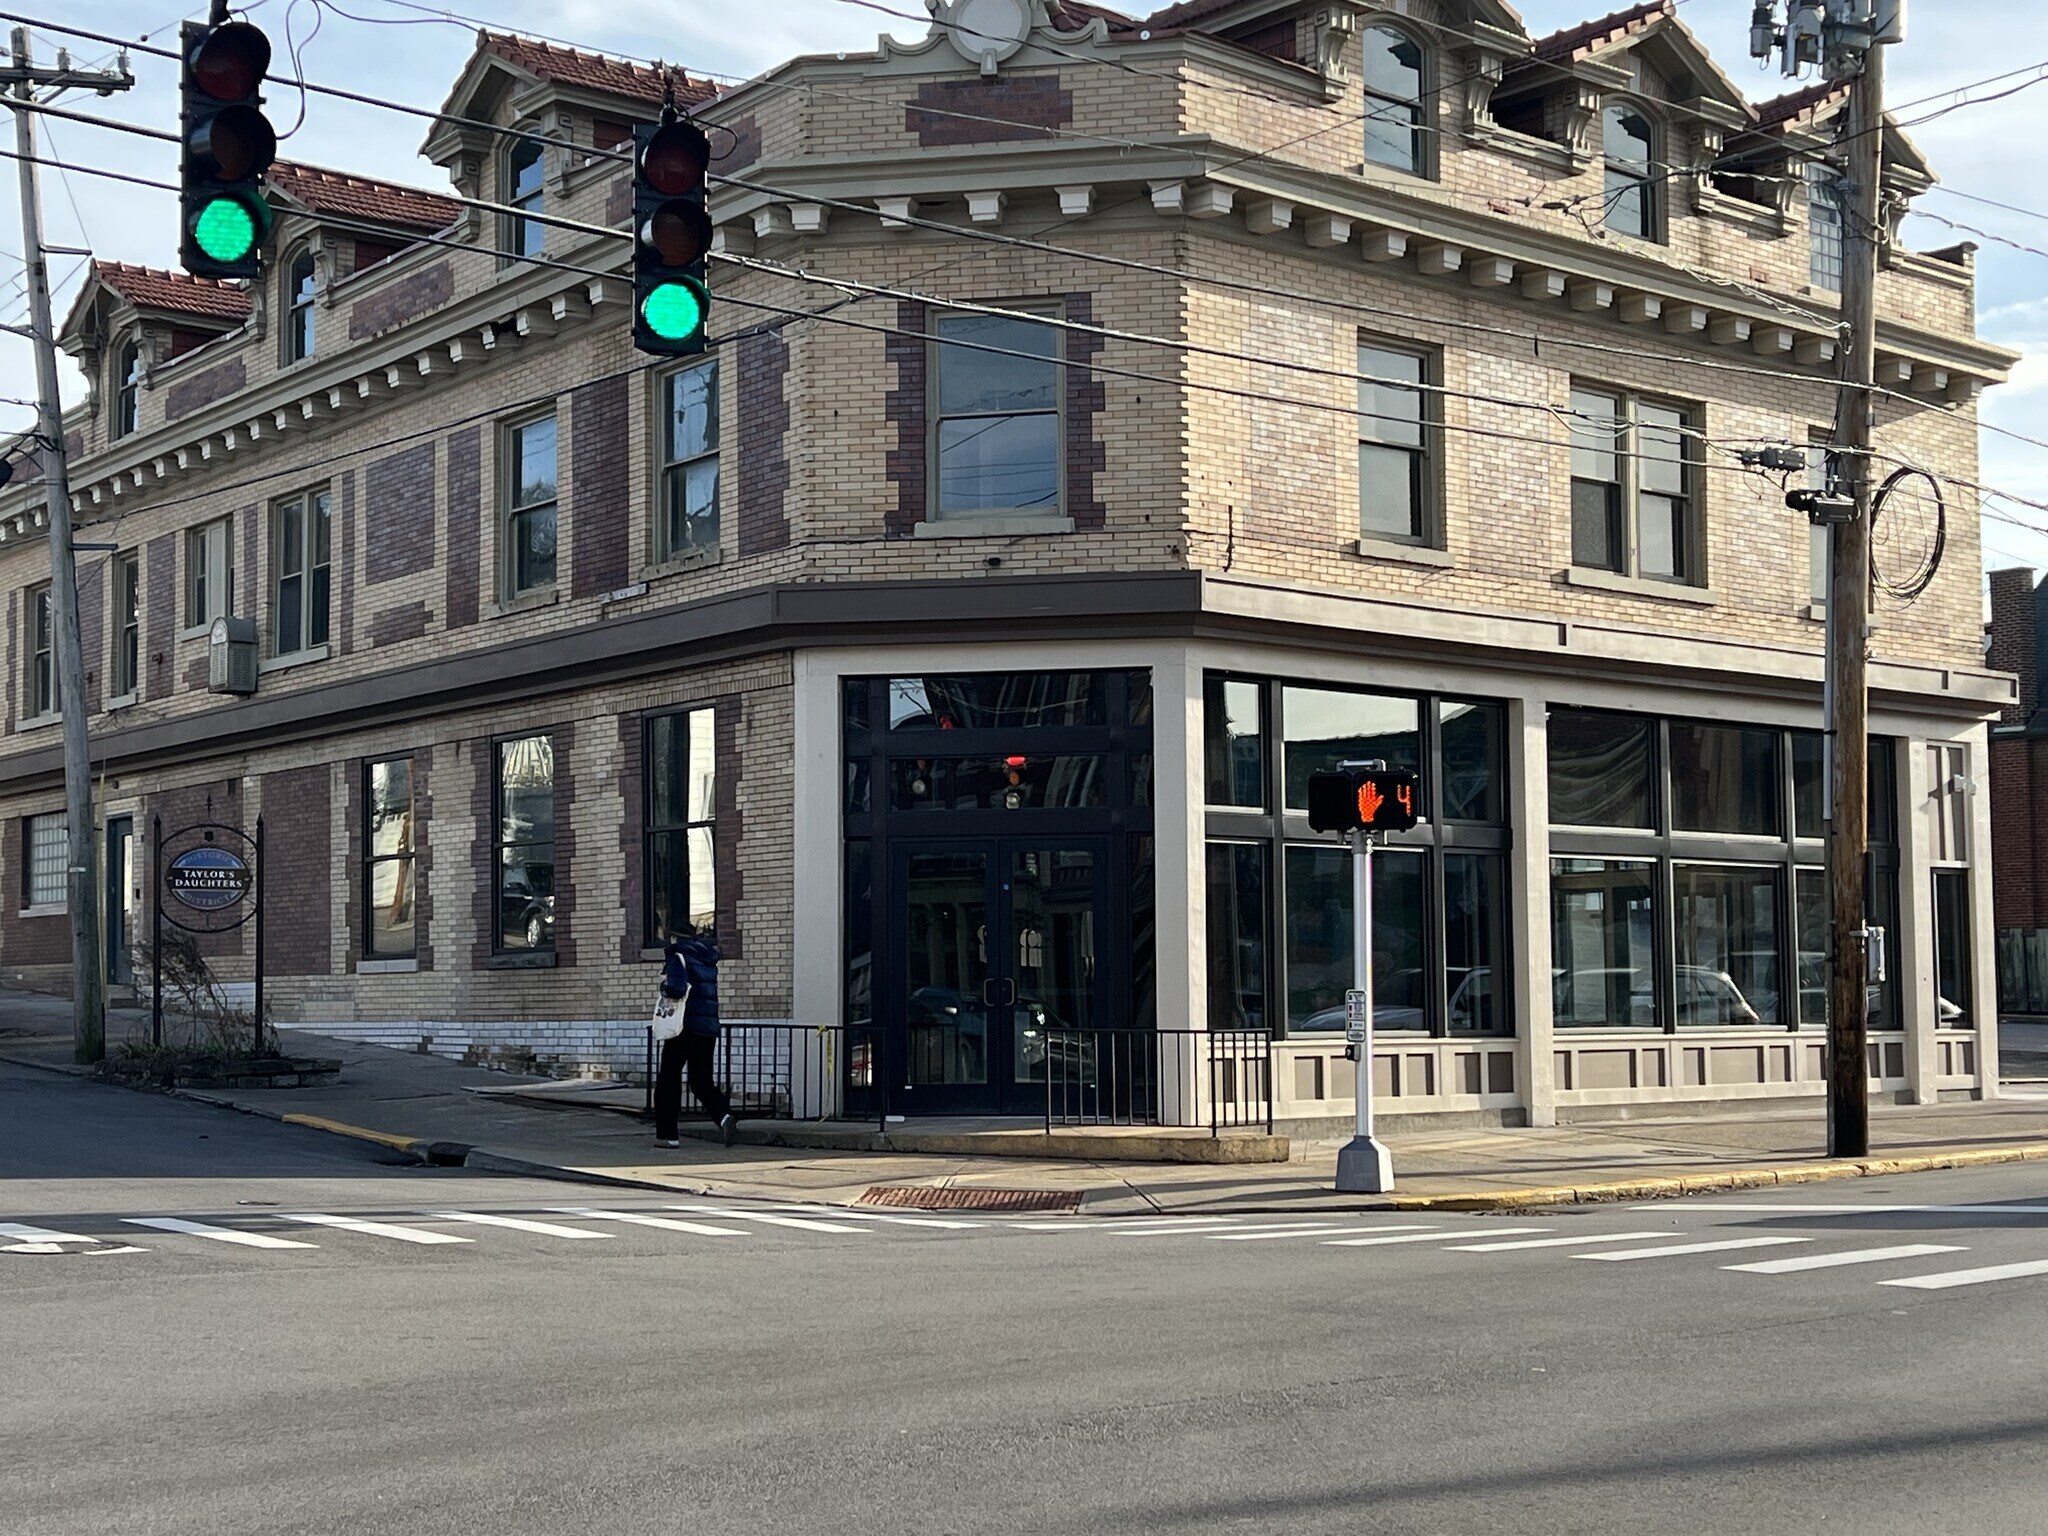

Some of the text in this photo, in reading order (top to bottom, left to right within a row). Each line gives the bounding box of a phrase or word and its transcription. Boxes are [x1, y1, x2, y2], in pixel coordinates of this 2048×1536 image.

[1397, 784, 1411, 817] 4
[183, 870, 235, 878] TAYLOR'S
[175, 879, 242, 887] DAUGHTERS
